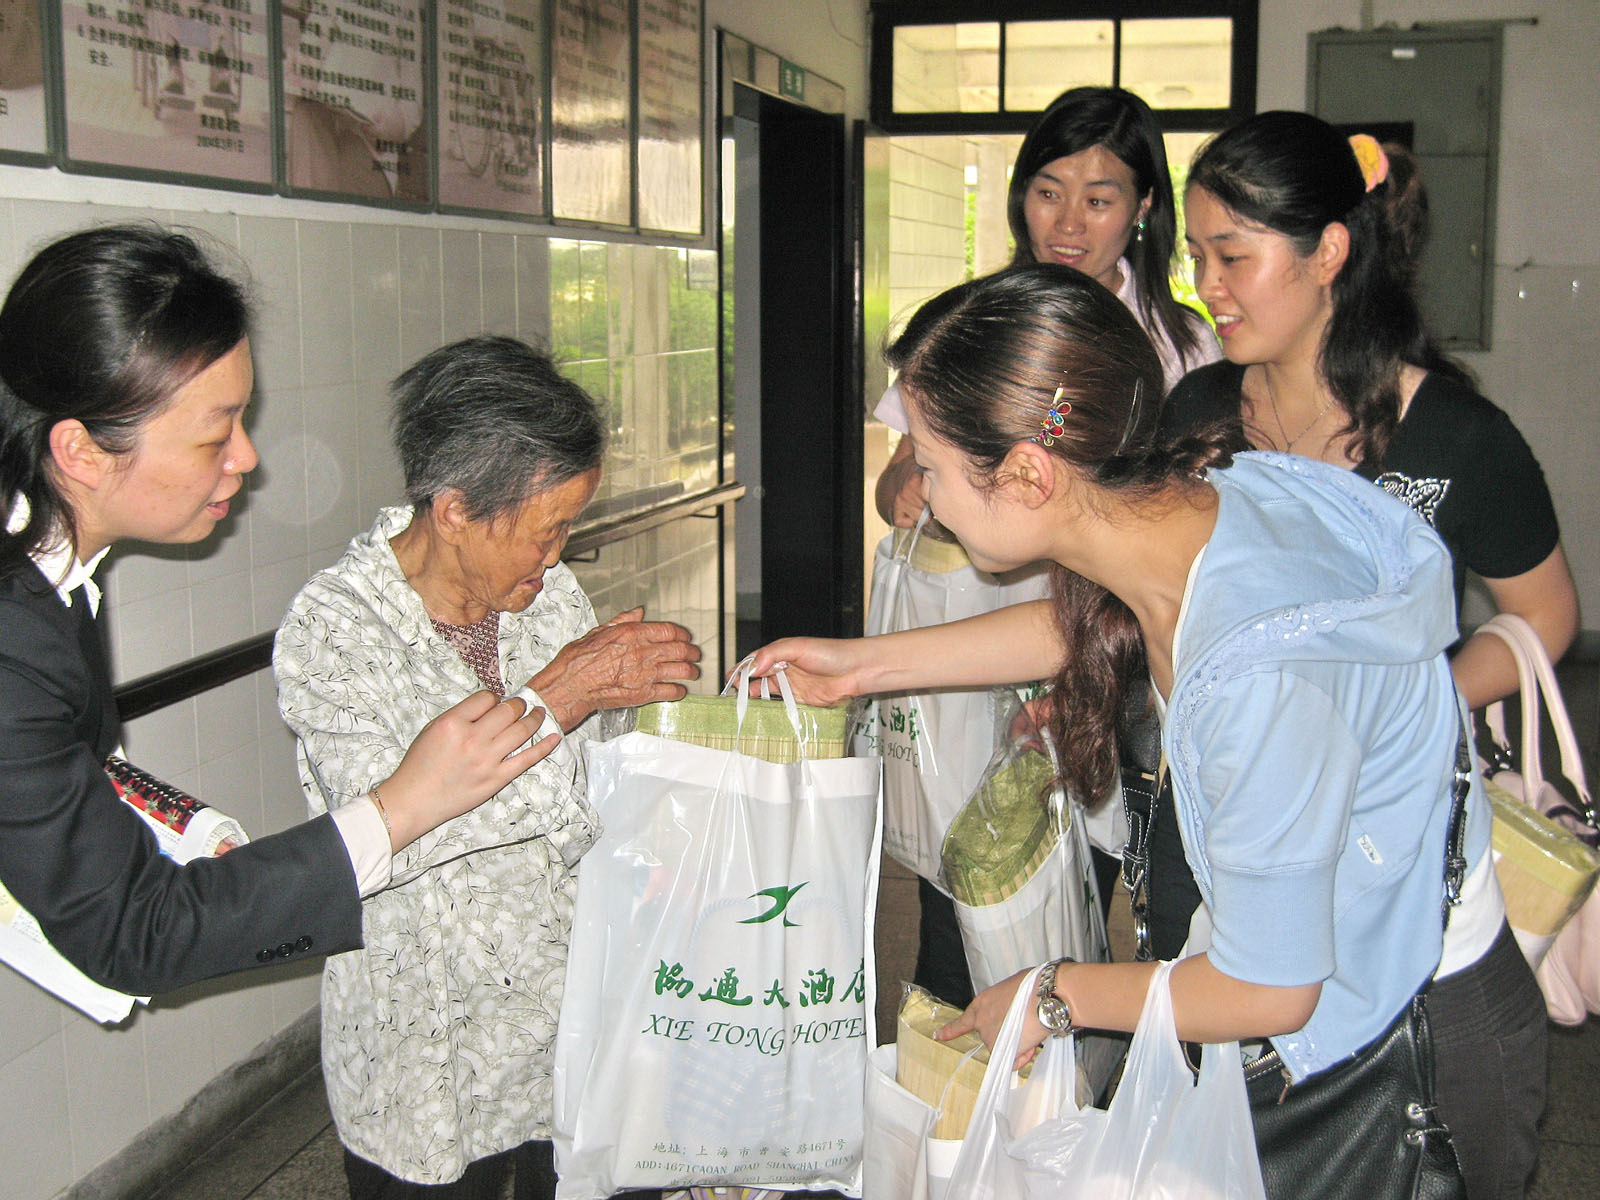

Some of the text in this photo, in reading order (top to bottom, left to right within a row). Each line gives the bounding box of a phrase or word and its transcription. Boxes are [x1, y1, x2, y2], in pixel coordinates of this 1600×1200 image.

[642, 1014, 867, 1056] XIE TONG HOTE
[733, 1162, 760, 1173] ROAD
